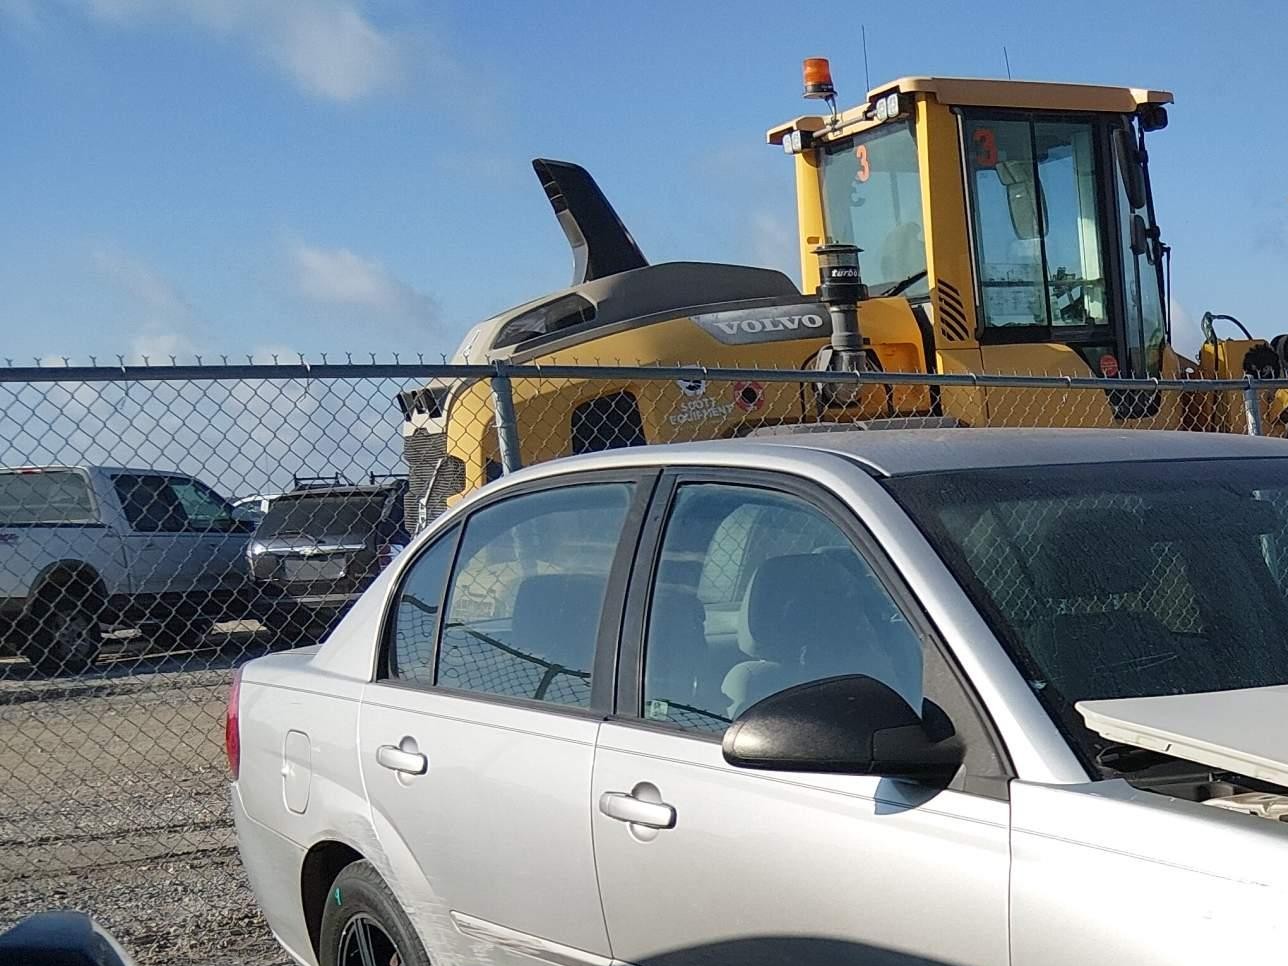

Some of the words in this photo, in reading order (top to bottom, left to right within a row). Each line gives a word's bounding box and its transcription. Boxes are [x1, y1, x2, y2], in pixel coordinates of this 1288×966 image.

[973, 128, 998, 166] 3
[855, 144, 871, 182] 3
[714, 314, 823, 335] VOLVO
[669, 404, 734, 425] EQUIPMENT
[680, 396, 717, 412] SCOTT
